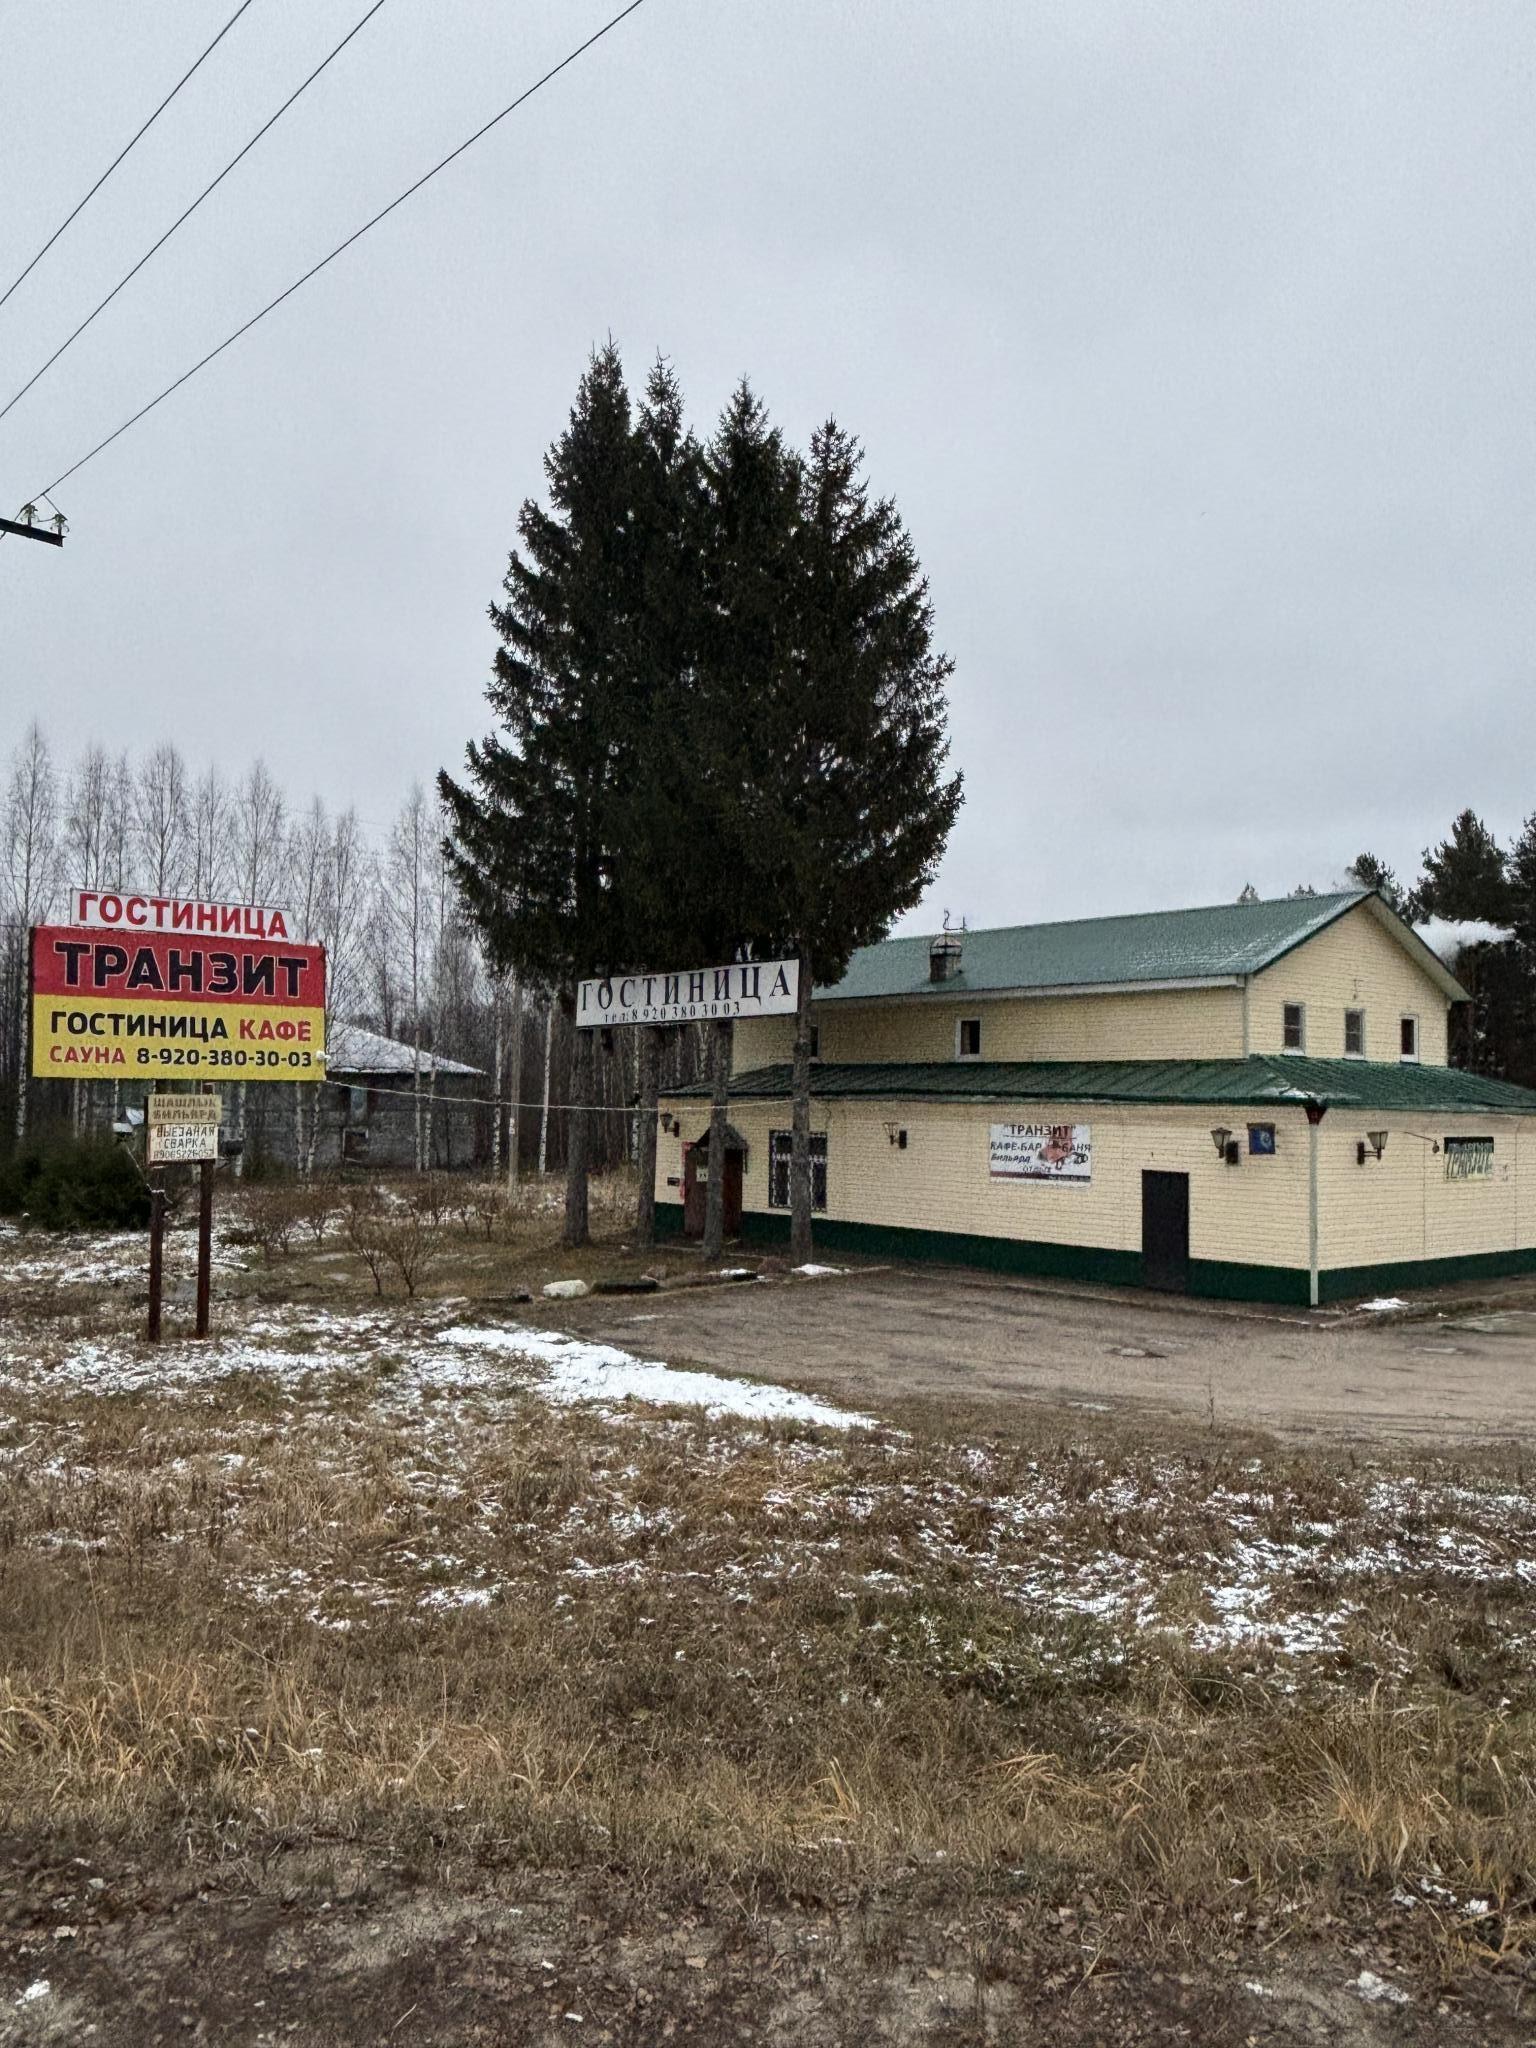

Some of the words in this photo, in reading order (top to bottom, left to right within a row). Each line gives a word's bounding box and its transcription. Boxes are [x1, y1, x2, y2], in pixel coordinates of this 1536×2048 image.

[78, 892, 289, 941] ГОСТИНИЦА
[53, 940, 309, 998] ТРАНЗИТ
[582, 963, 791, 1012] ГОСТИНИЦА
[50, 1010, 229, 1043] ГОСТИНИЦА
[239, 1018, 312, 1042] КАФЕ
[643, 1006, 666, 1020] 920
[672, 1004, 696, 1019] 380
[701, 1002, 718, 1017] 30
[723, 1001, 741, 1015] 03
[49, 1045, 126, 1065] САУНА
[136, 1047, 312, 1067] 8-920-380-30-03
[164, 1138, 207, 1149] СВАРКА
